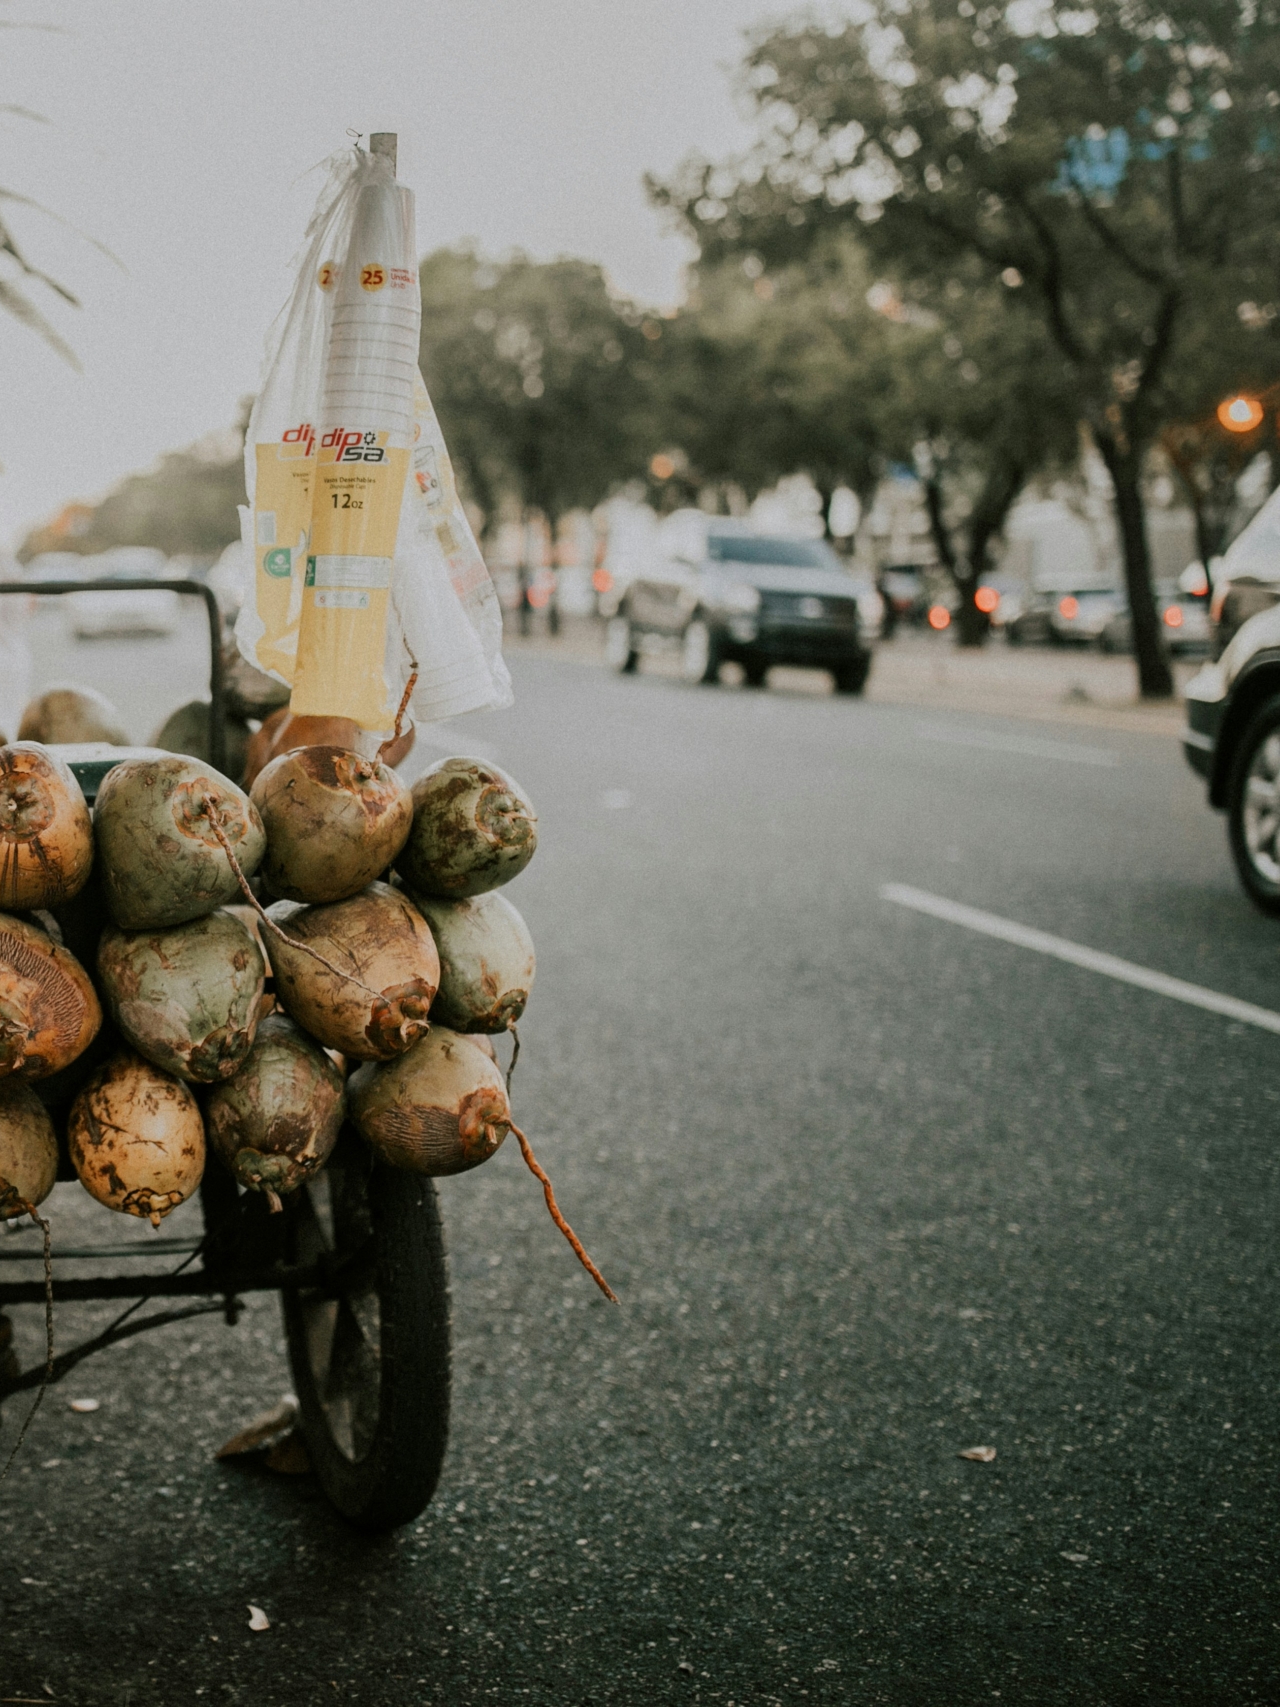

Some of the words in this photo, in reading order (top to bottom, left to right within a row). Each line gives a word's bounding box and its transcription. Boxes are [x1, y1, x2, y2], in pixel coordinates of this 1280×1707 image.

[362, 269, 384, 285] 25
[321, 428, 363, 462] dip
[342, 446, 385, 462] sa
